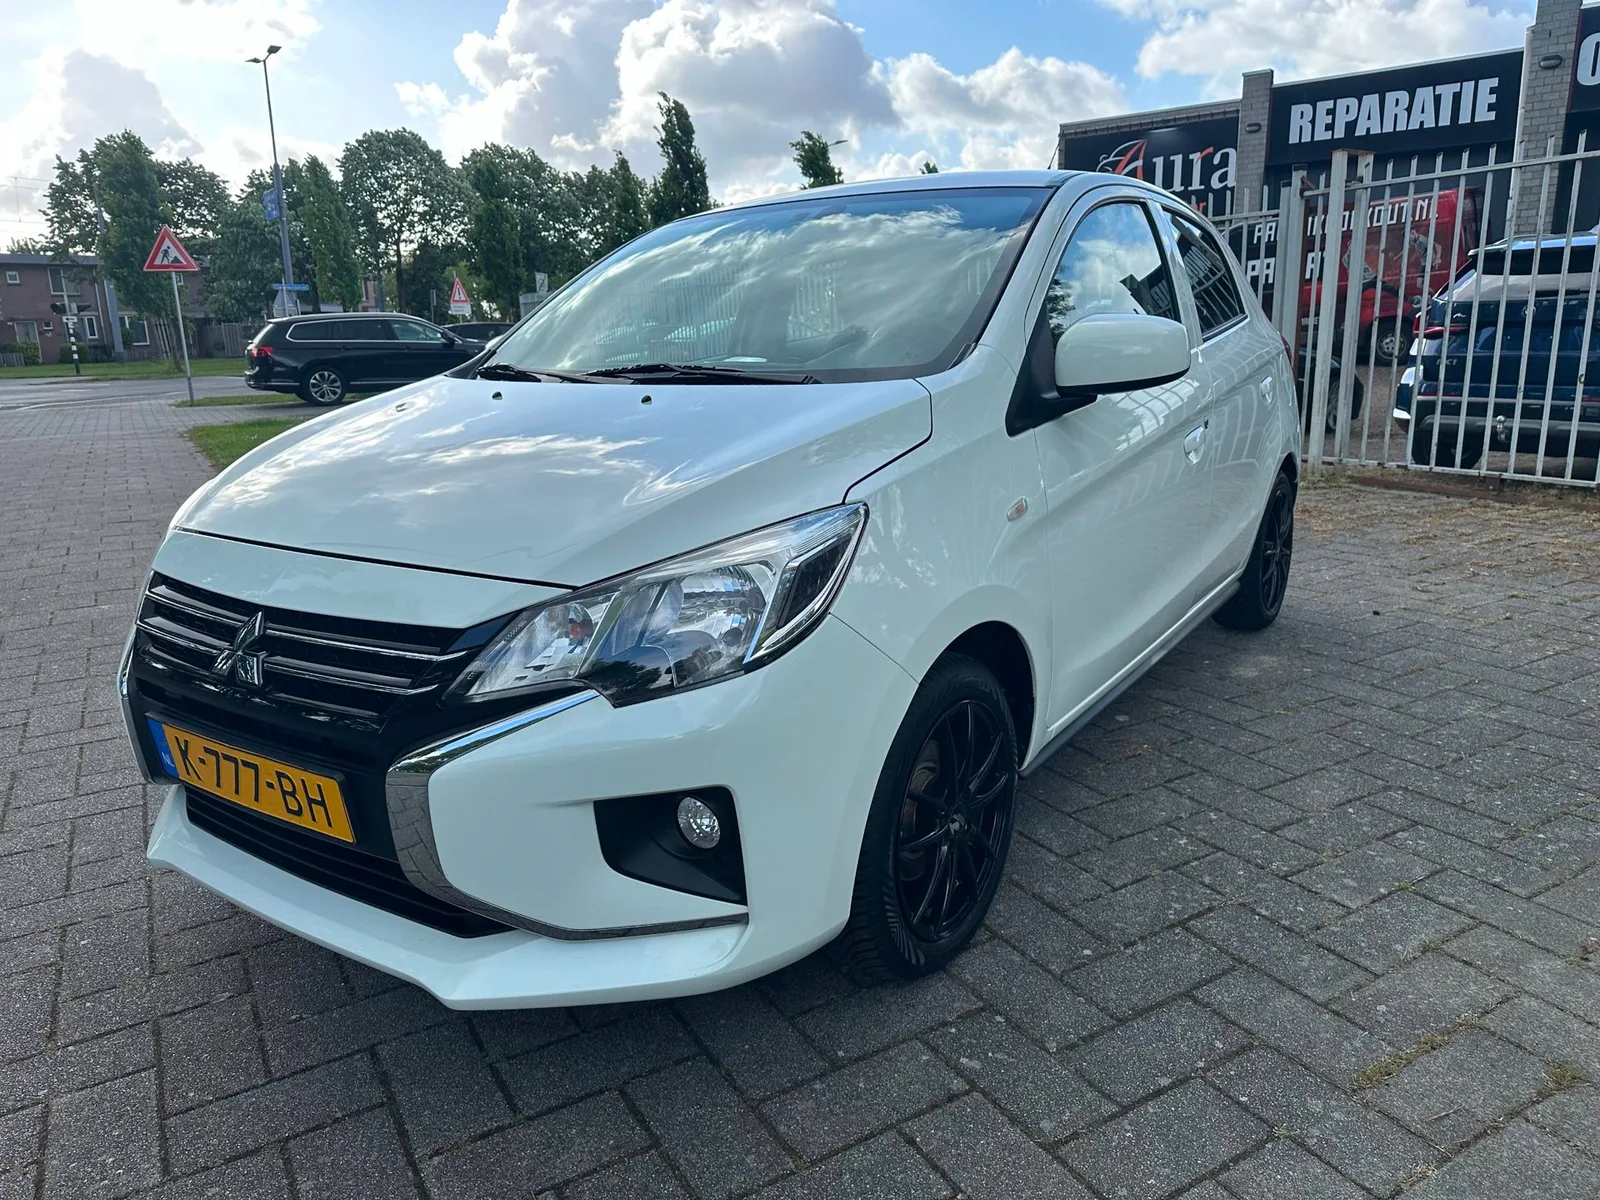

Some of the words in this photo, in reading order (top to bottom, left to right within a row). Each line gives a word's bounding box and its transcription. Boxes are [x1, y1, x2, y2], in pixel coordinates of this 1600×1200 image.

[1288, 77, 1499, 144] REPARATIE
[1096, 139, 1237, 193] Aura
[174, 735, 334, 828] K-777-BH
